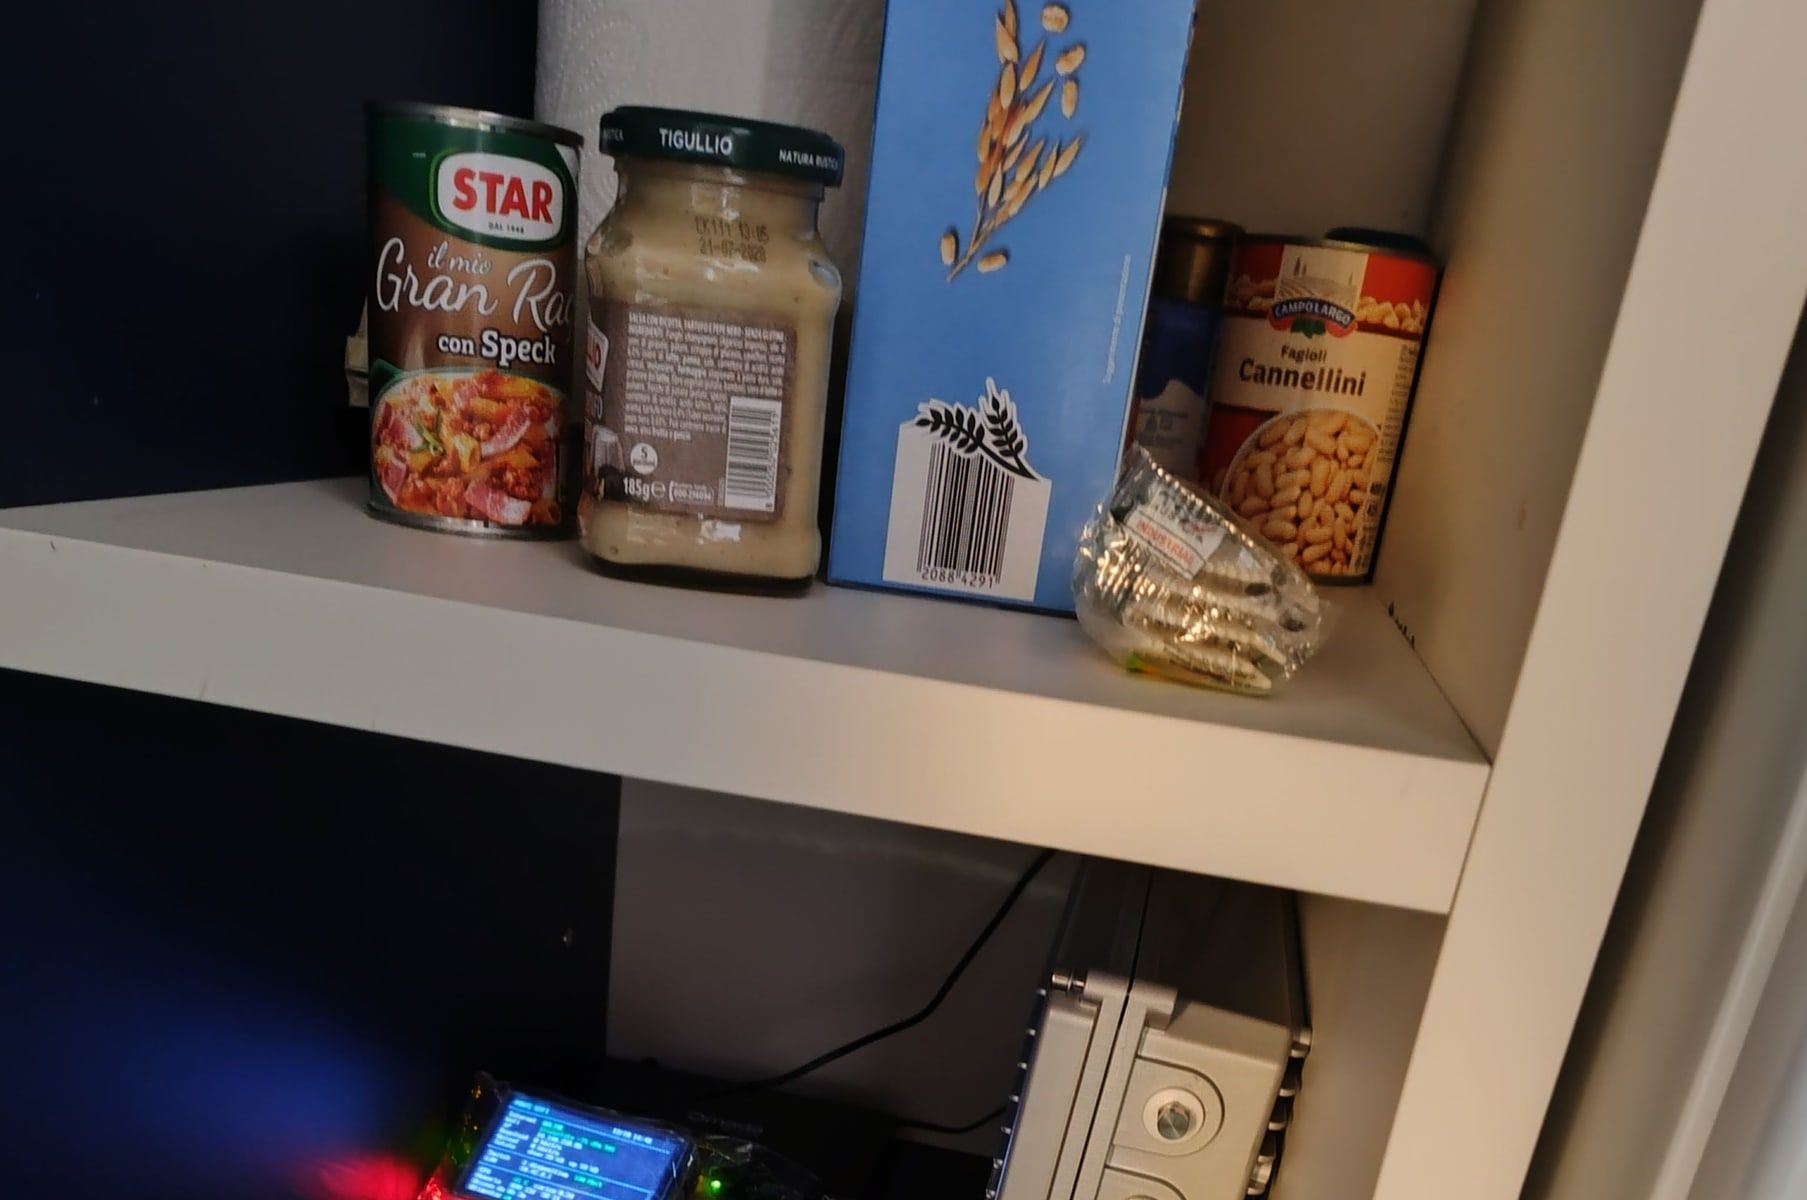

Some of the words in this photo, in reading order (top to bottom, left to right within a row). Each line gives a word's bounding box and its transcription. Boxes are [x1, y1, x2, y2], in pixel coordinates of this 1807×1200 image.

[658, 128, 733, 155] TIGULLIO
[779, 149, 814, 166] NATURA
[453, 168, 553, 223] STAR
[428, 240, 448, 269] il
[449, 252, 491, 274] mio
[376, 237, 498, 316] Gran
[1274, 301, 1351, 326] CAMPOLARGO
[437, 335, 475, 356] con
[481, 329, 557, 368] Speck
[1281, 345, 1327, 364] Fagioli
[1239, 359, 1367, 397] Cannellini
[623, 477, 649, 501] 185g
[922, 567, 954, 583] 2088
[962, 572, 993, 589] 4291
